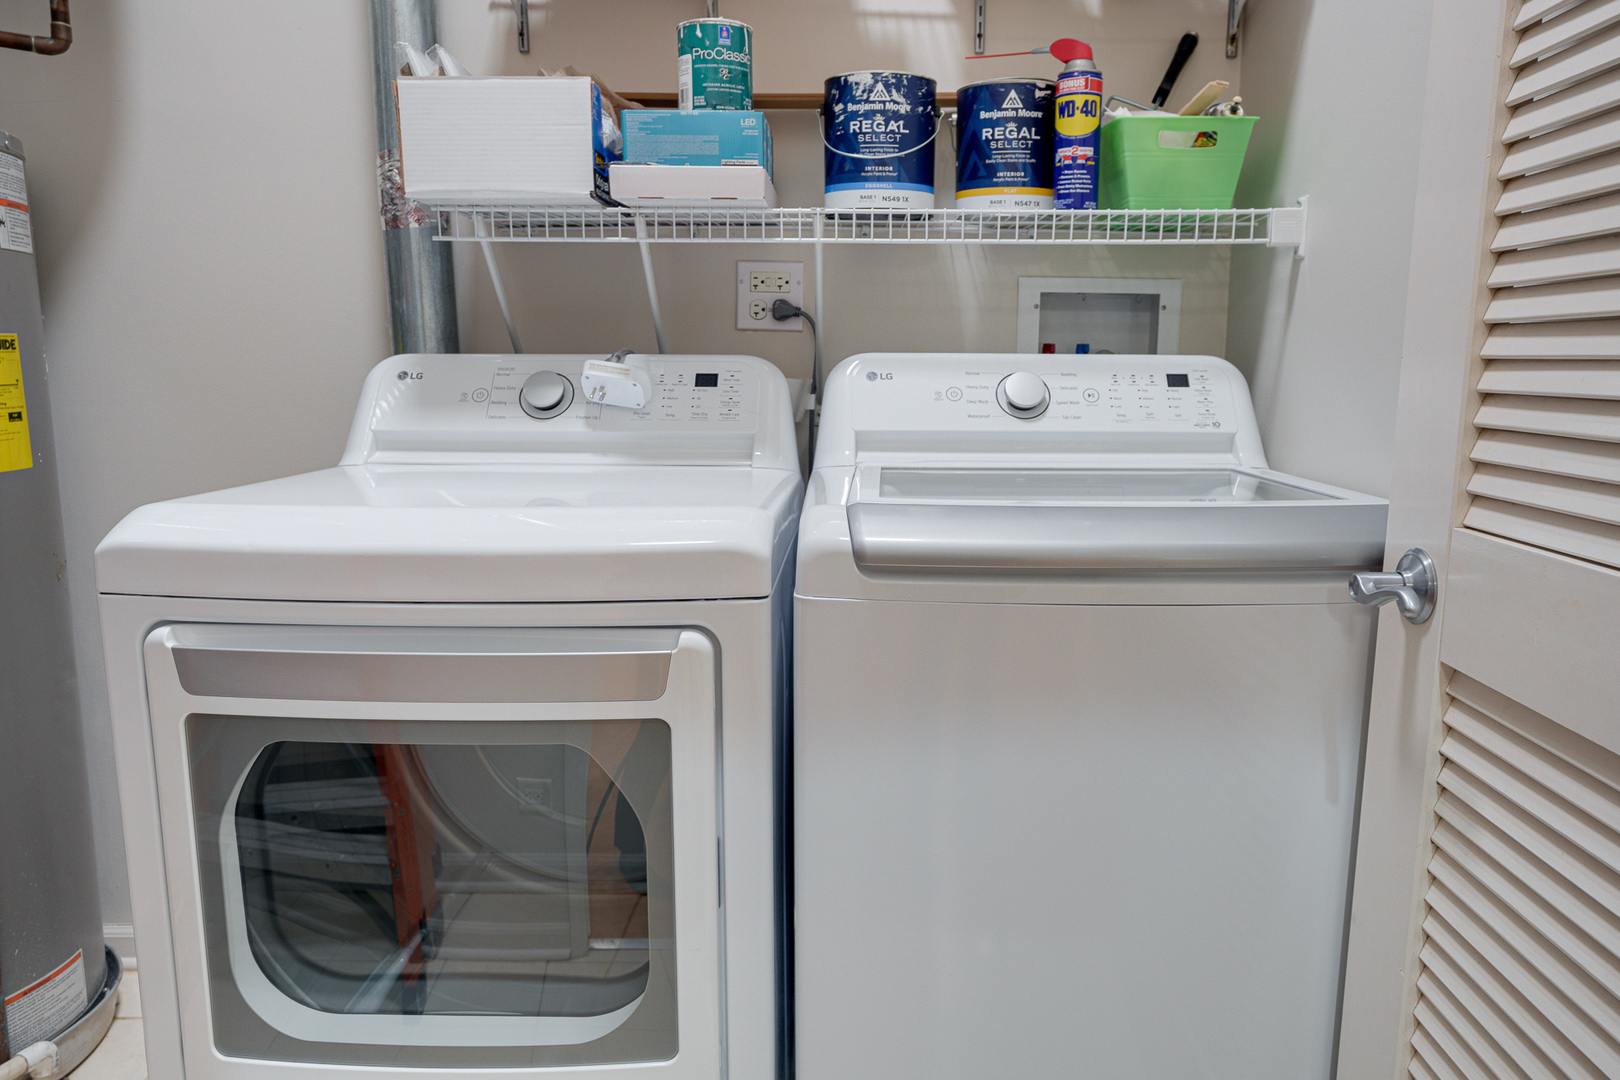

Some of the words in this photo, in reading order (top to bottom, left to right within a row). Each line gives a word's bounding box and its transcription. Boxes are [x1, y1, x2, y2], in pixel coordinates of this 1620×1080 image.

[1059, 78, 1086, 89] BONUS
[847, 102, 884, 114] Benjamin
[885, 102, 911, 112] Moore
[1058, 99, 1098, 120] WD-40
[980, 108, 1017, 120] Benjamin
[1018, 108, 1043, 118] Moore
[740, 118, 756, 126] LED
[849, 120, 910, 134] REGAL
[858, 134, 902, 142] SELECT
[982, 126, 1041, 140] REGAL
[990, 140, 1034, 149] SELECT
[1072, 146, 1079, 156] 2
[410, 372, 424, 380] LG
[880, 372, 894, 380] LG
